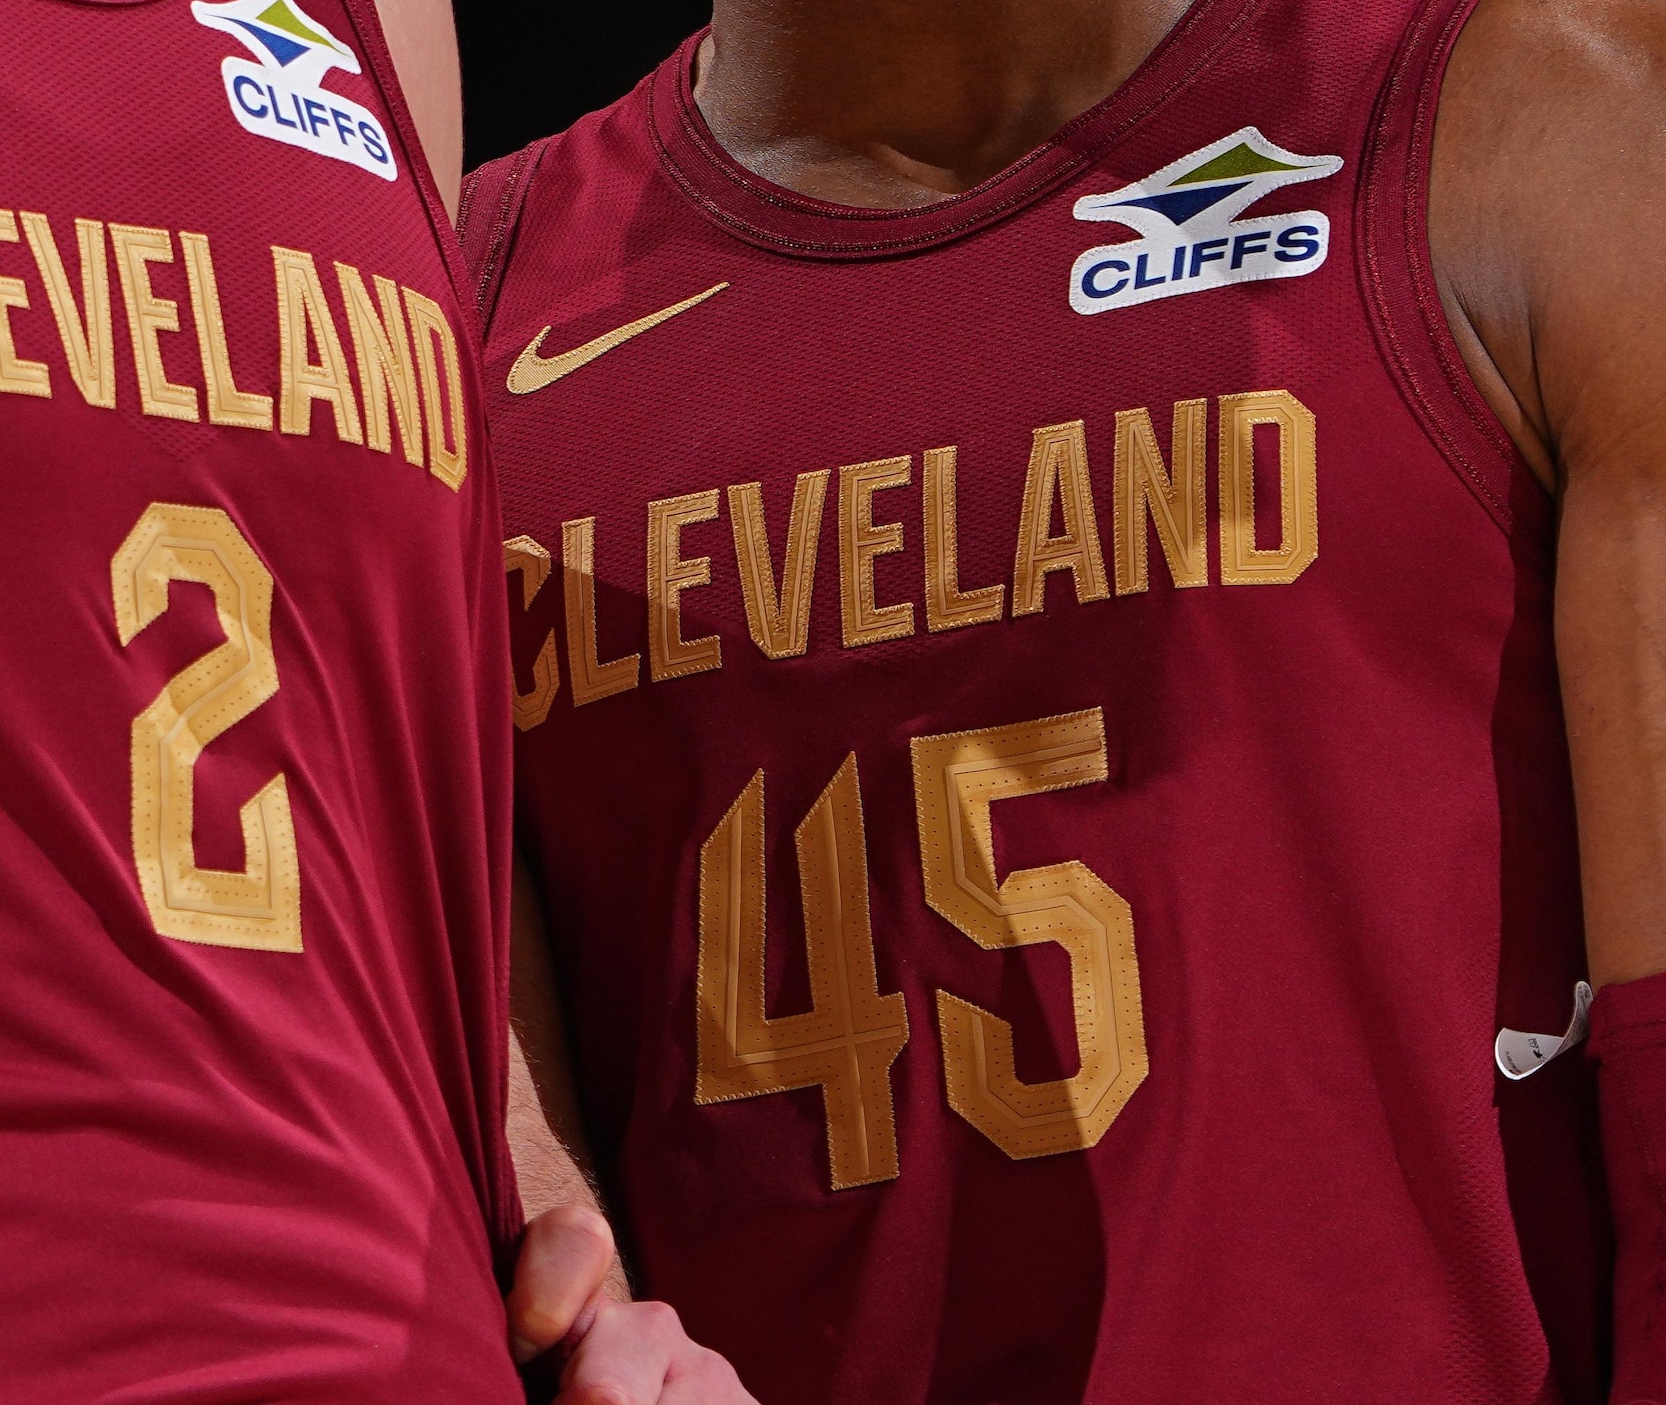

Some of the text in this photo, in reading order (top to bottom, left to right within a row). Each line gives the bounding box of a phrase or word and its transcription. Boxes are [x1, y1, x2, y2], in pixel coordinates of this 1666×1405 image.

[233, 75, 389, 165] CLIFFS
[1081, 224, 1320, 299] CLIFFS
[111, 501, 304, 954] 2
[503, 390, 1320, 732] CLEVELAND
[694, 707, 1149, 1191] 45
